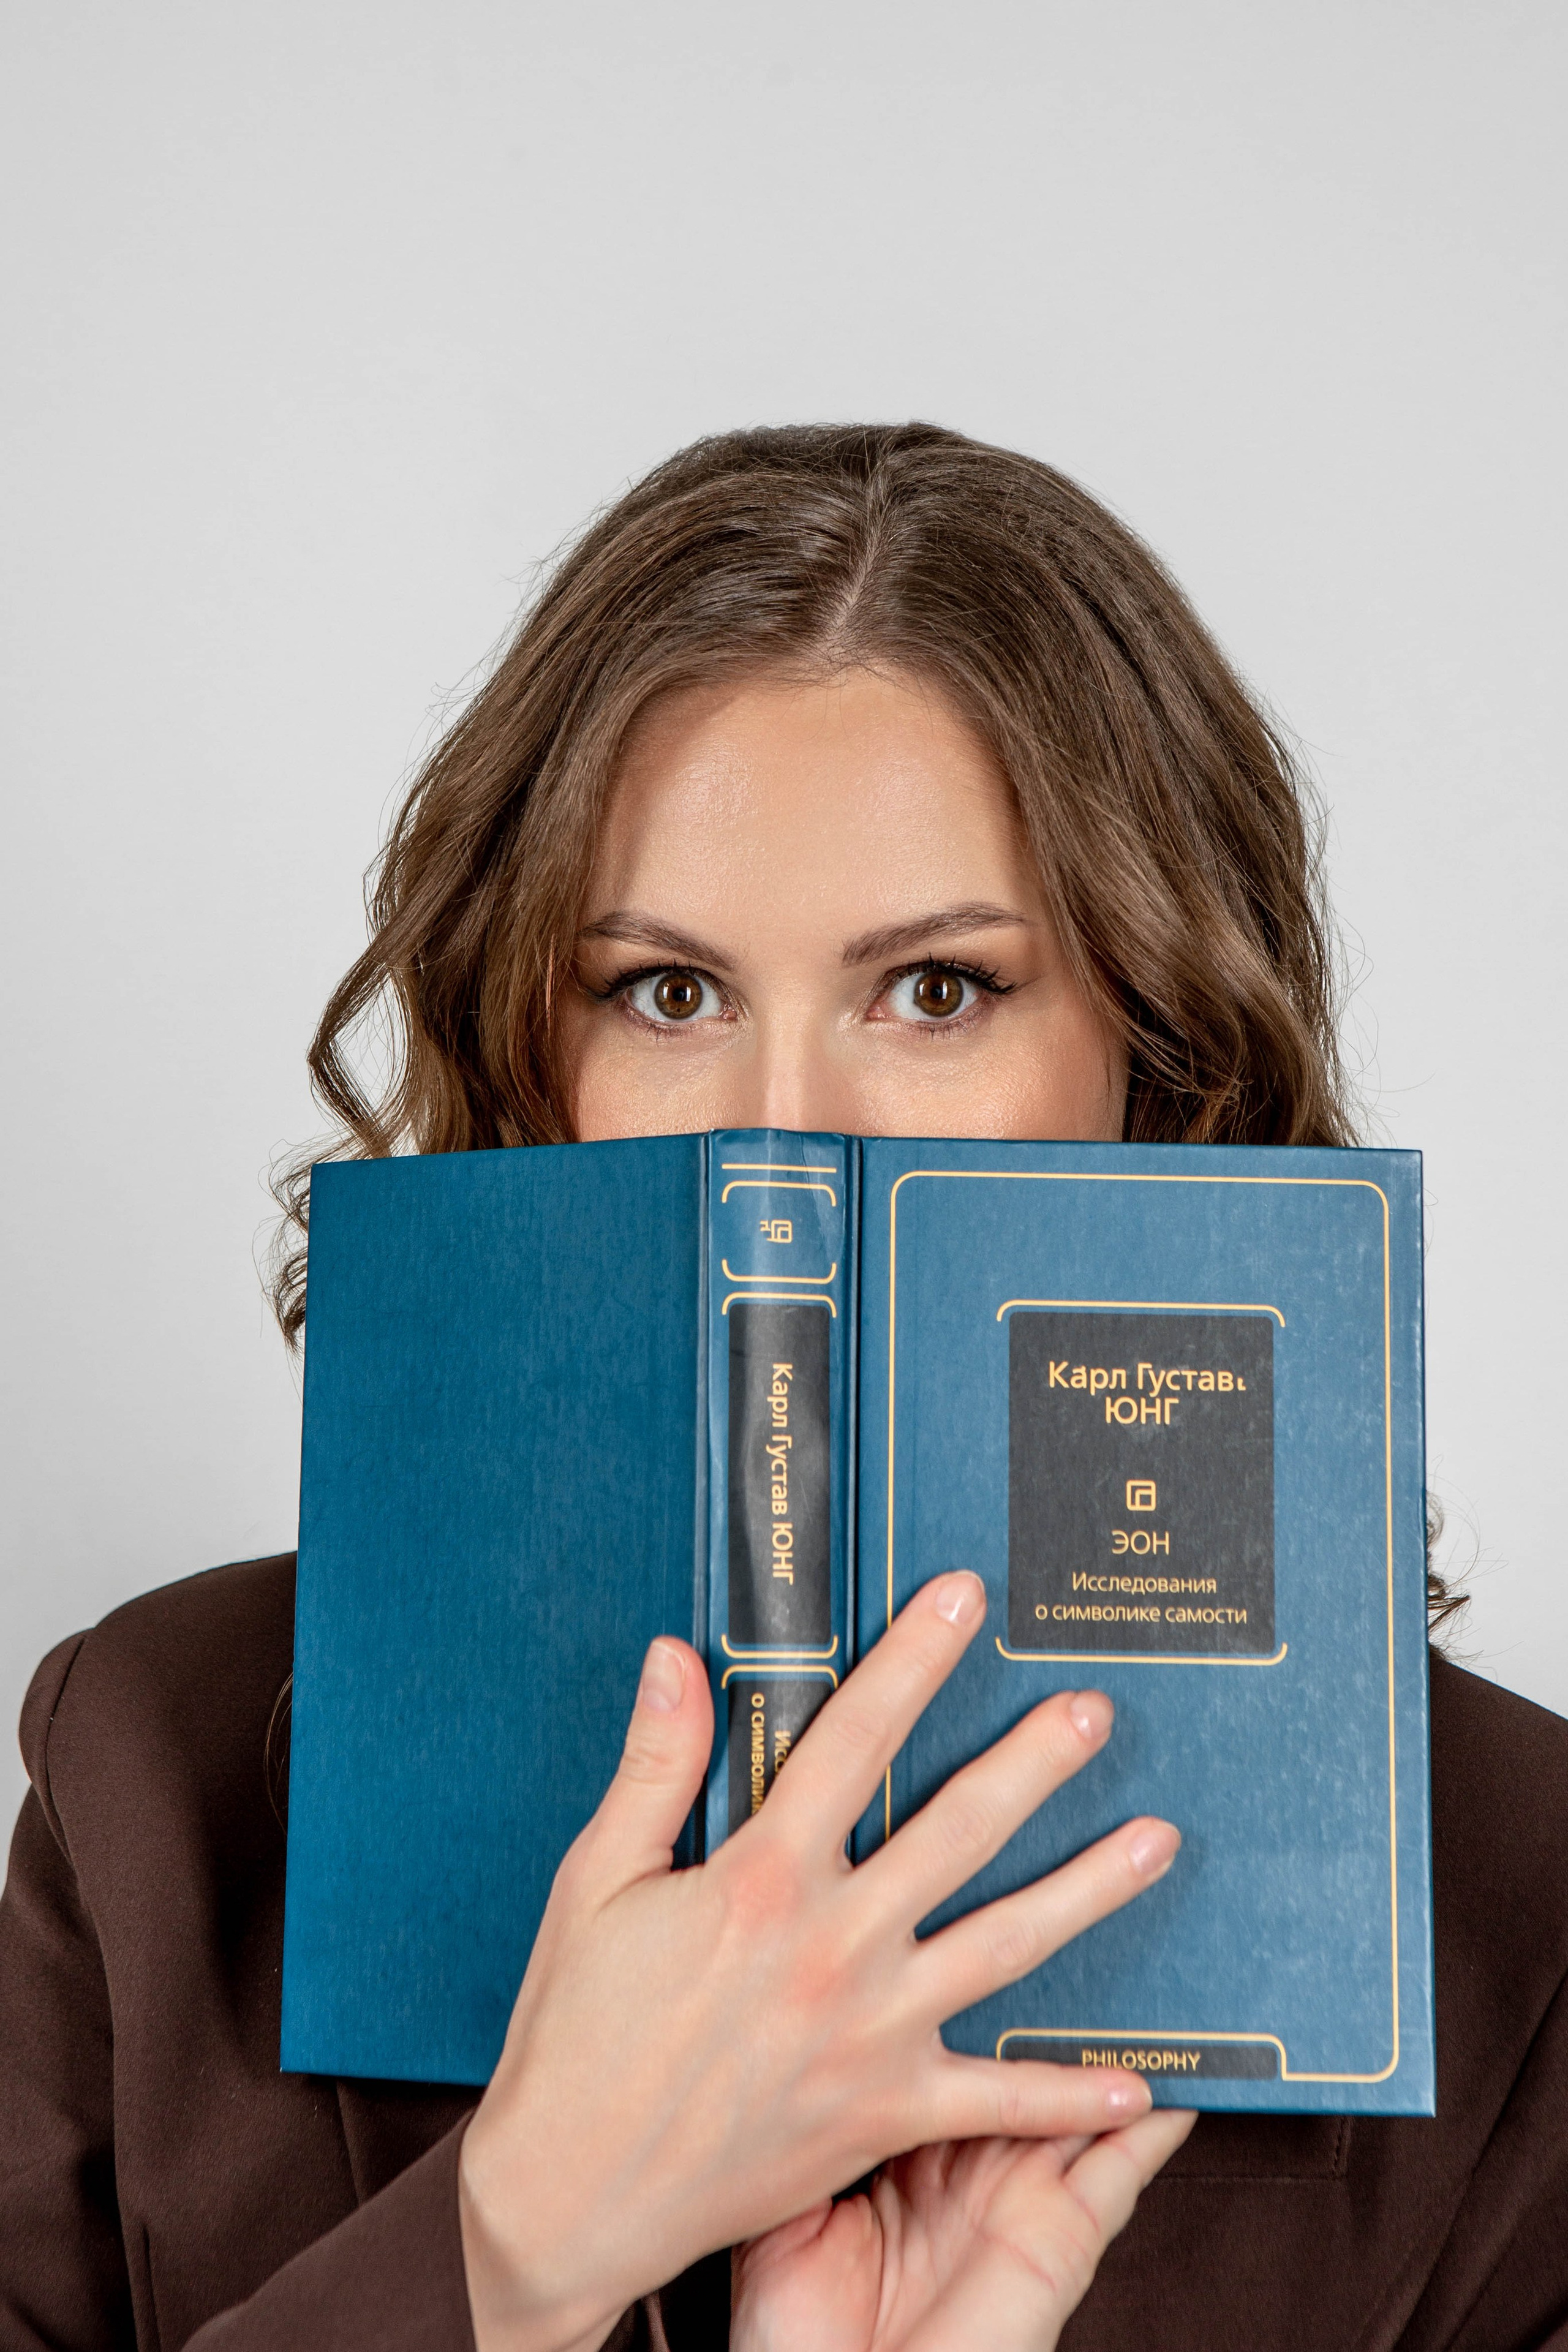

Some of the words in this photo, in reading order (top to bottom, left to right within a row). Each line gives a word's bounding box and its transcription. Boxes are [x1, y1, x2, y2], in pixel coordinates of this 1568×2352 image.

[1049, 1360, 1126, 1396] Карл
[767, 1363, 793, 1428] Карл
[1105, 1396, 1179, 1425] ЮНГ
[766, 1434, 792, 1516] Густав
[772, 1522, 793, 1585] ЮНГ
[1111, 1530, 1169, 1555] ЭОН
[1072, 1571, 1217, 1595] Исследования
[1035, 1604, 1048, 1620] о
[1052, 1604, 1161, 1623] символике
[1165, 1606, 1247, 1624] самости
[751, 1692, 764, 1708] о
[1082, 2049, 1200, 2071] PHILOSOPHY
